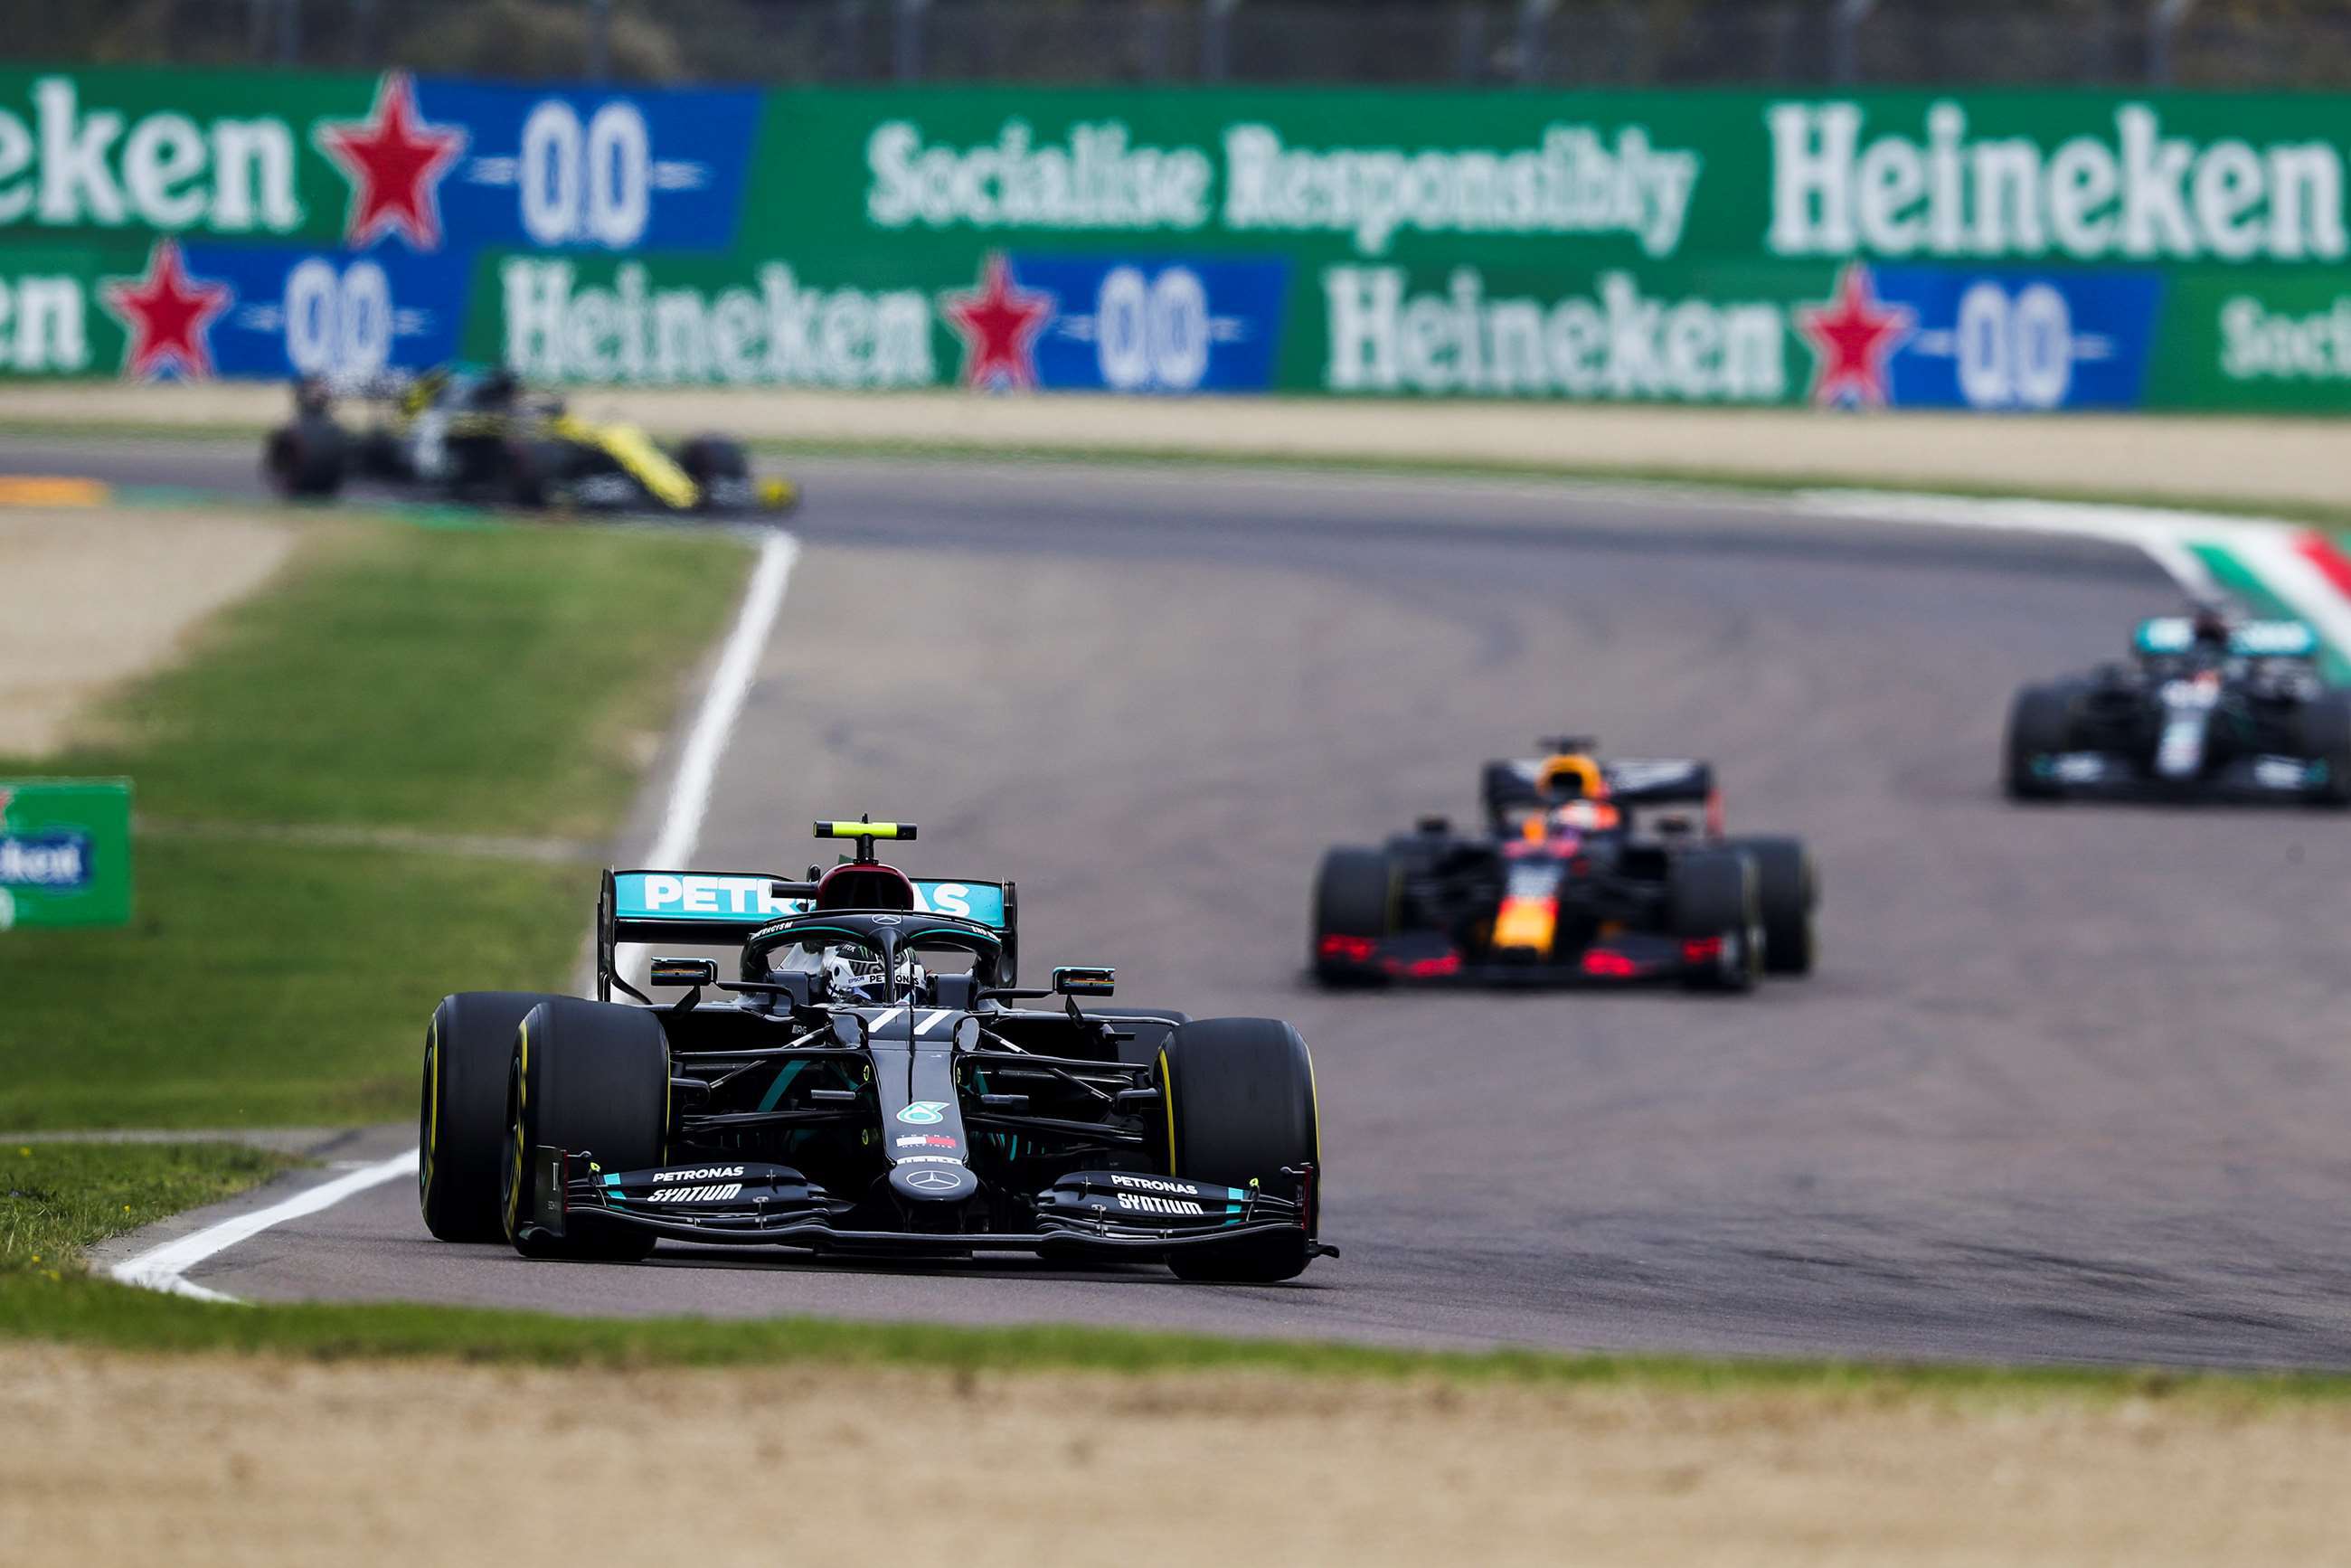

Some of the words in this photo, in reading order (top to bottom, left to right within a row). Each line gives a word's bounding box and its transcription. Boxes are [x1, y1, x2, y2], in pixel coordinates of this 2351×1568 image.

[867, 122, 1211, 228] Socialise
[1224, 125, 1698, 253] Responsibly
[1768, 101, 2347, 258] Heineken
[500, 258, 935, 382] Heineken
[1326, 266, 1787, 397] Heineken
[645, 874, 970, 918] PETRS
[854, 1006, 954, 1035] 77
[647, 1183, 742, 1202] SYNTIUM
[652, 1166, 745, 1183] PETRONAS
[1110, 1175, 1198, 1195] PETRONAS
[1117, 1193, 1204, 1215] SYNTIUM
